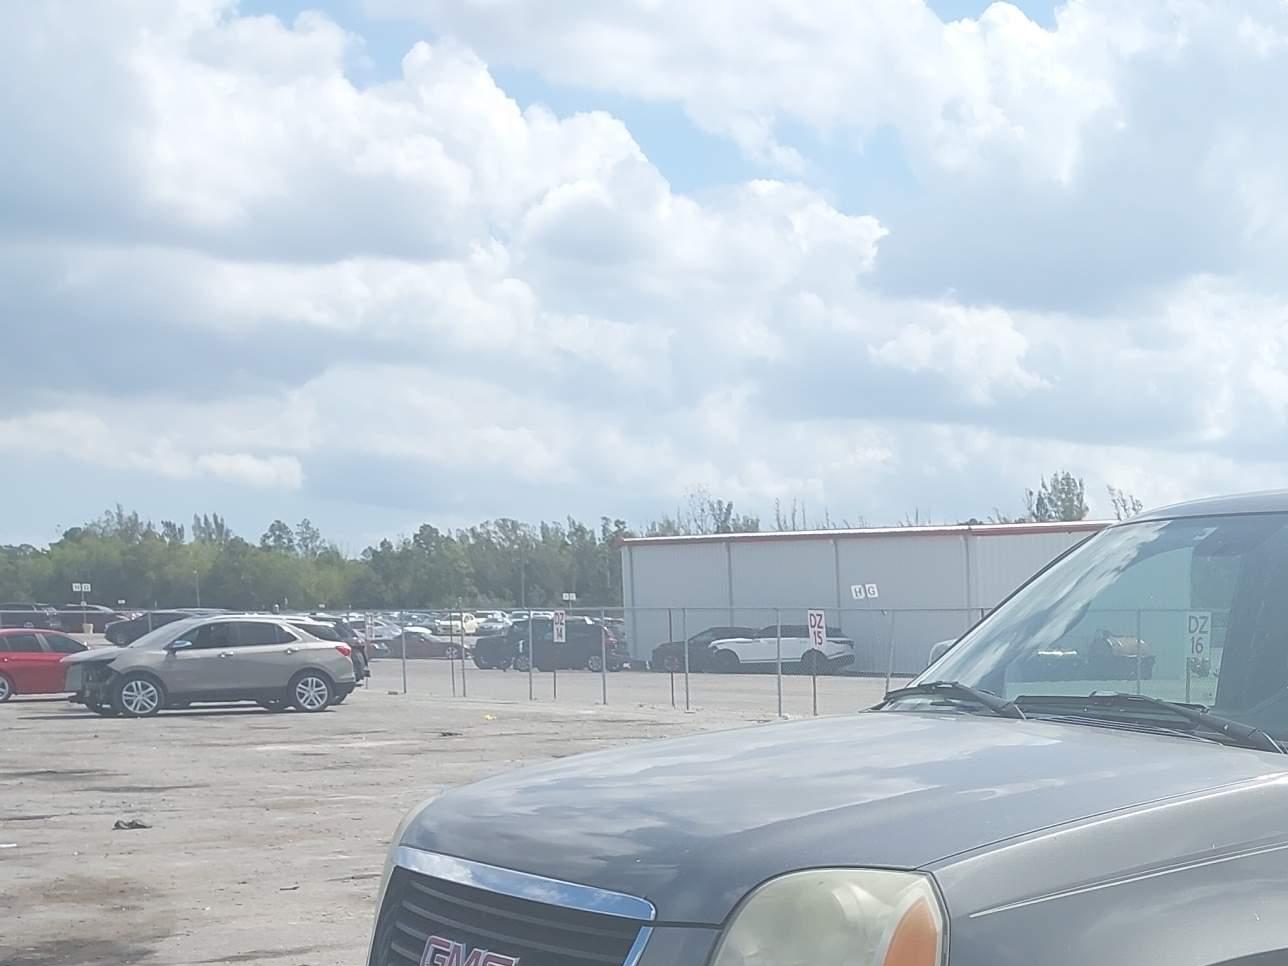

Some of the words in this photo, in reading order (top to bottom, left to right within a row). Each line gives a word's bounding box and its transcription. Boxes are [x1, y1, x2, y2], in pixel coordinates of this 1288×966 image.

[809, 613, 824, 629] DZ
[1188, 615, 1210, 634] DZ
[813, 630, 824, 646] 15
[1191, 636, 1204, 654] 16
